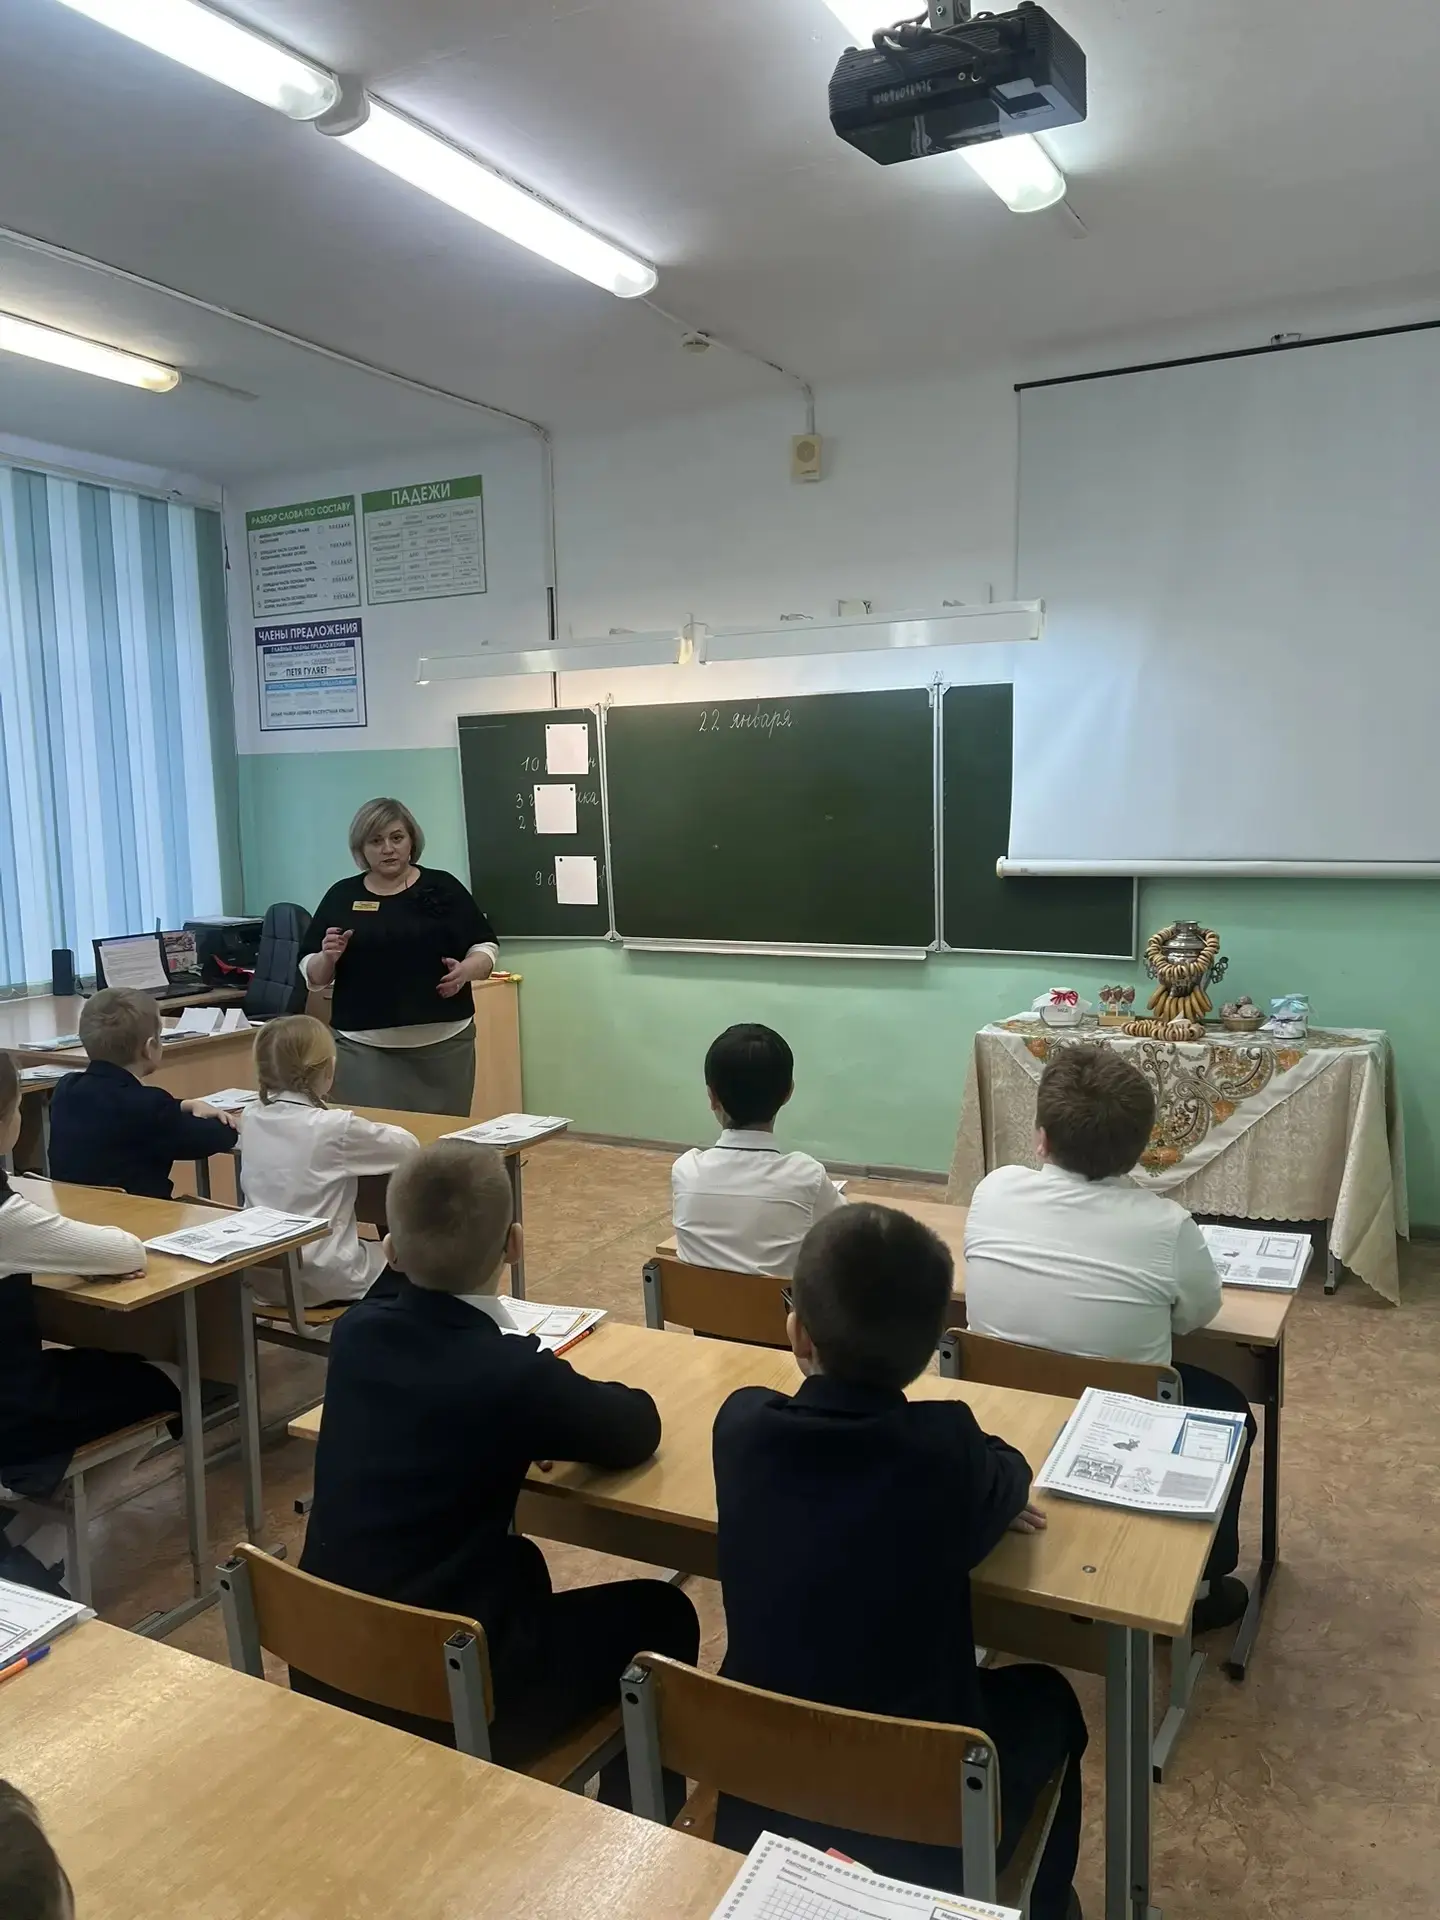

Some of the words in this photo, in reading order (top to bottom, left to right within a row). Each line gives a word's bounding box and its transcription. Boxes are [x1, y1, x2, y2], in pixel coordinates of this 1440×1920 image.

[391, 481, 451, 506] ПАДЕЖИ
[250, 513, 278, 525] РАЗБОР
[278, 508, 303, 521] СЛОВА
[304, 507, 316, 517] ПО
[316, 501, 351, 515] СОСТАВУ
[258, 630, 289, 642] ЧЛЕНЫ
[290, 622, 358, 640] ПРЕДЛОЖЕНИЯ
[285, 667, 302, 677] ПЕТЯ
[303, 665, 328, 676] ГУЛЯЕТ
[698, 708, 720, 732] 22
[729, 703, 792, 739] января
[520, 756, 540, 772] 10
[515, 793, 524, 809] 3
[518, 815, 526, 830] 2
